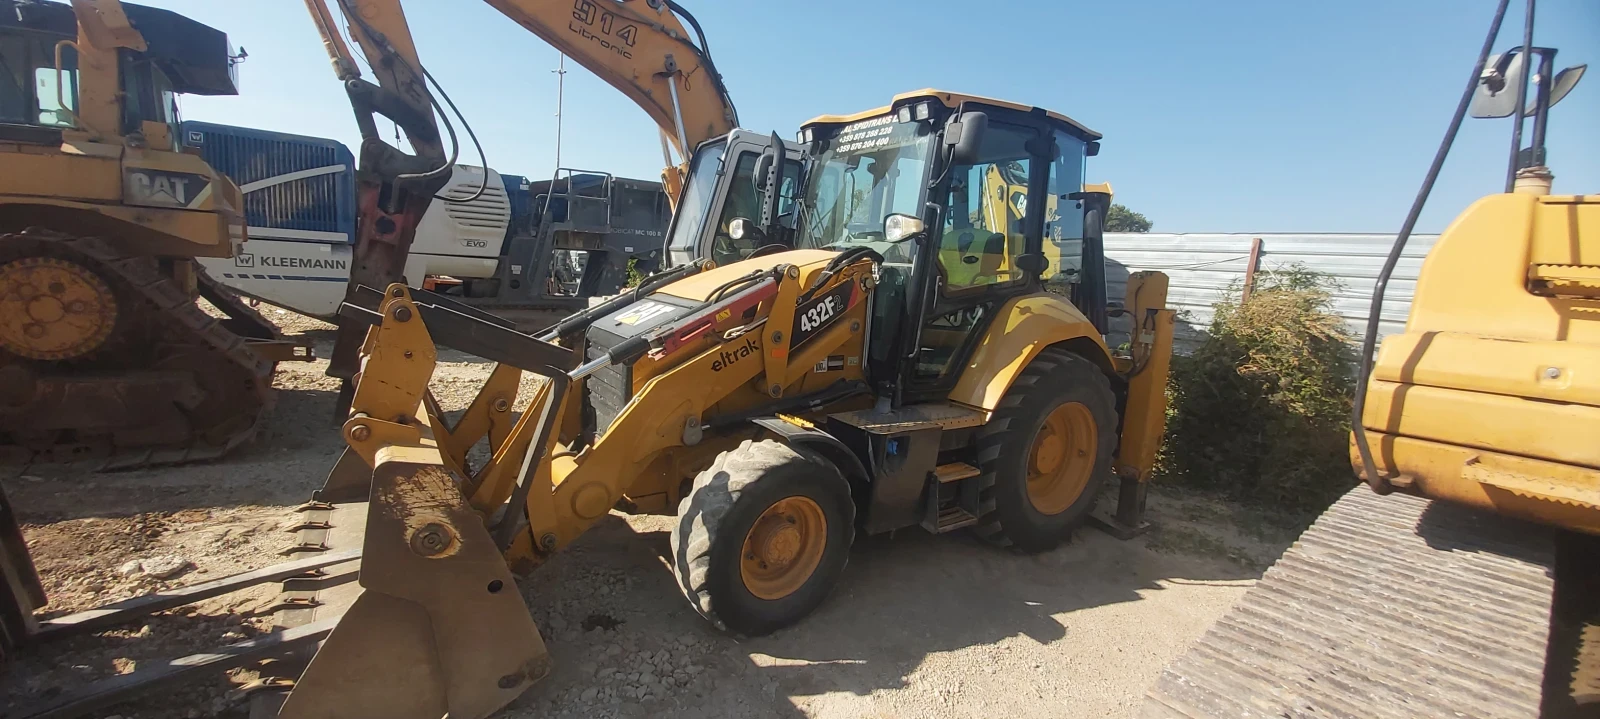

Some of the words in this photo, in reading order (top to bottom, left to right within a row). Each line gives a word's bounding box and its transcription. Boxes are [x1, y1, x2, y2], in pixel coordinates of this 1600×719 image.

[573, 0, 637, 47] 914
[569, 21, 632, 59] Litronic
[836, 144, 850, 153] +359
[862, 140, 875, 148] 204
[875, 137, 889, 146] 400
[839, 134, 853, 143] +359
[131, 172, 188, 204] CAT
[466, 240, 486, 248] EVO
[260, 256, 346, 269] KLEEMANN
[614, 301, 676, 326] CAT
[711, 338, 760, 372] eltrak
